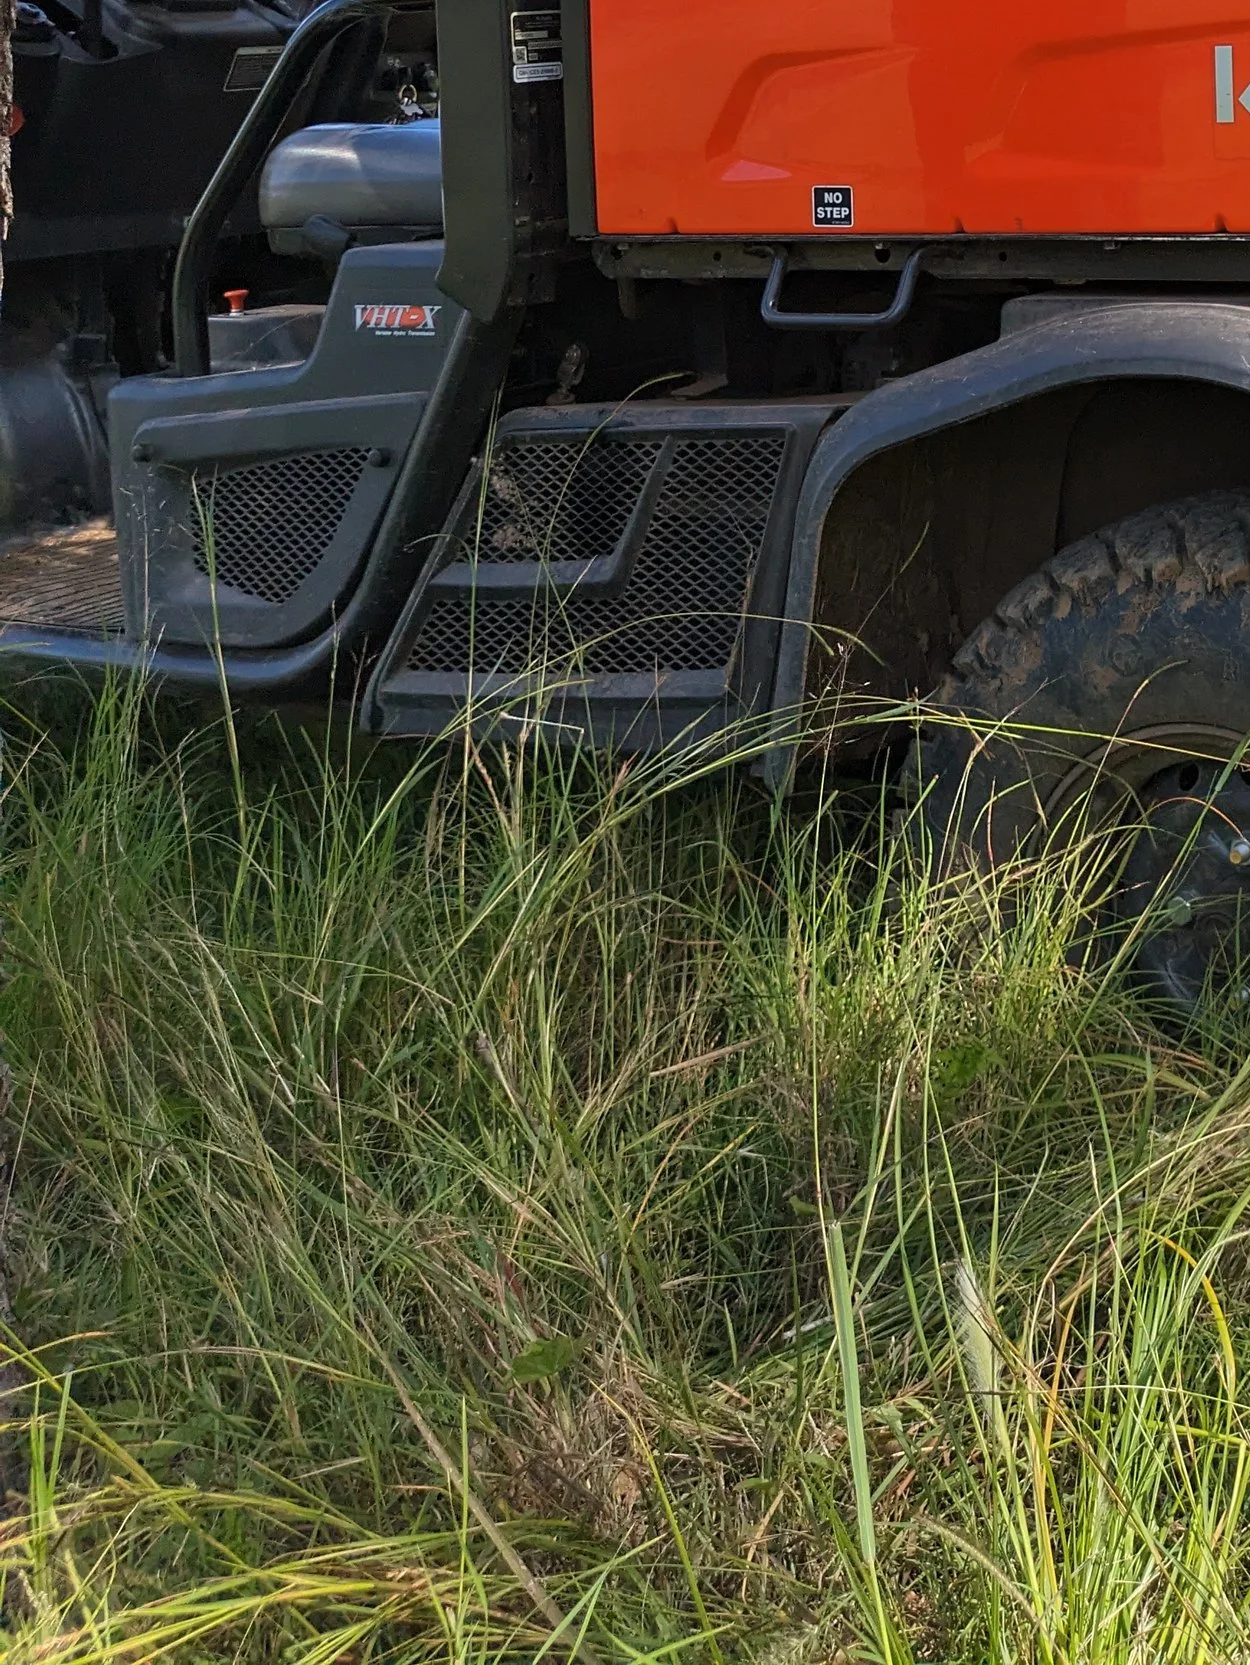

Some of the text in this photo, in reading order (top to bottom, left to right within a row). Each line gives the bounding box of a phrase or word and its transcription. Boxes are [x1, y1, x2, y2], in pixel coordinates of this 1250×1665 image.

[824, 192, 843, 204] NO
[816, 206, 850, 219] STEP
[354, 304, 442, 332] VHT-X
